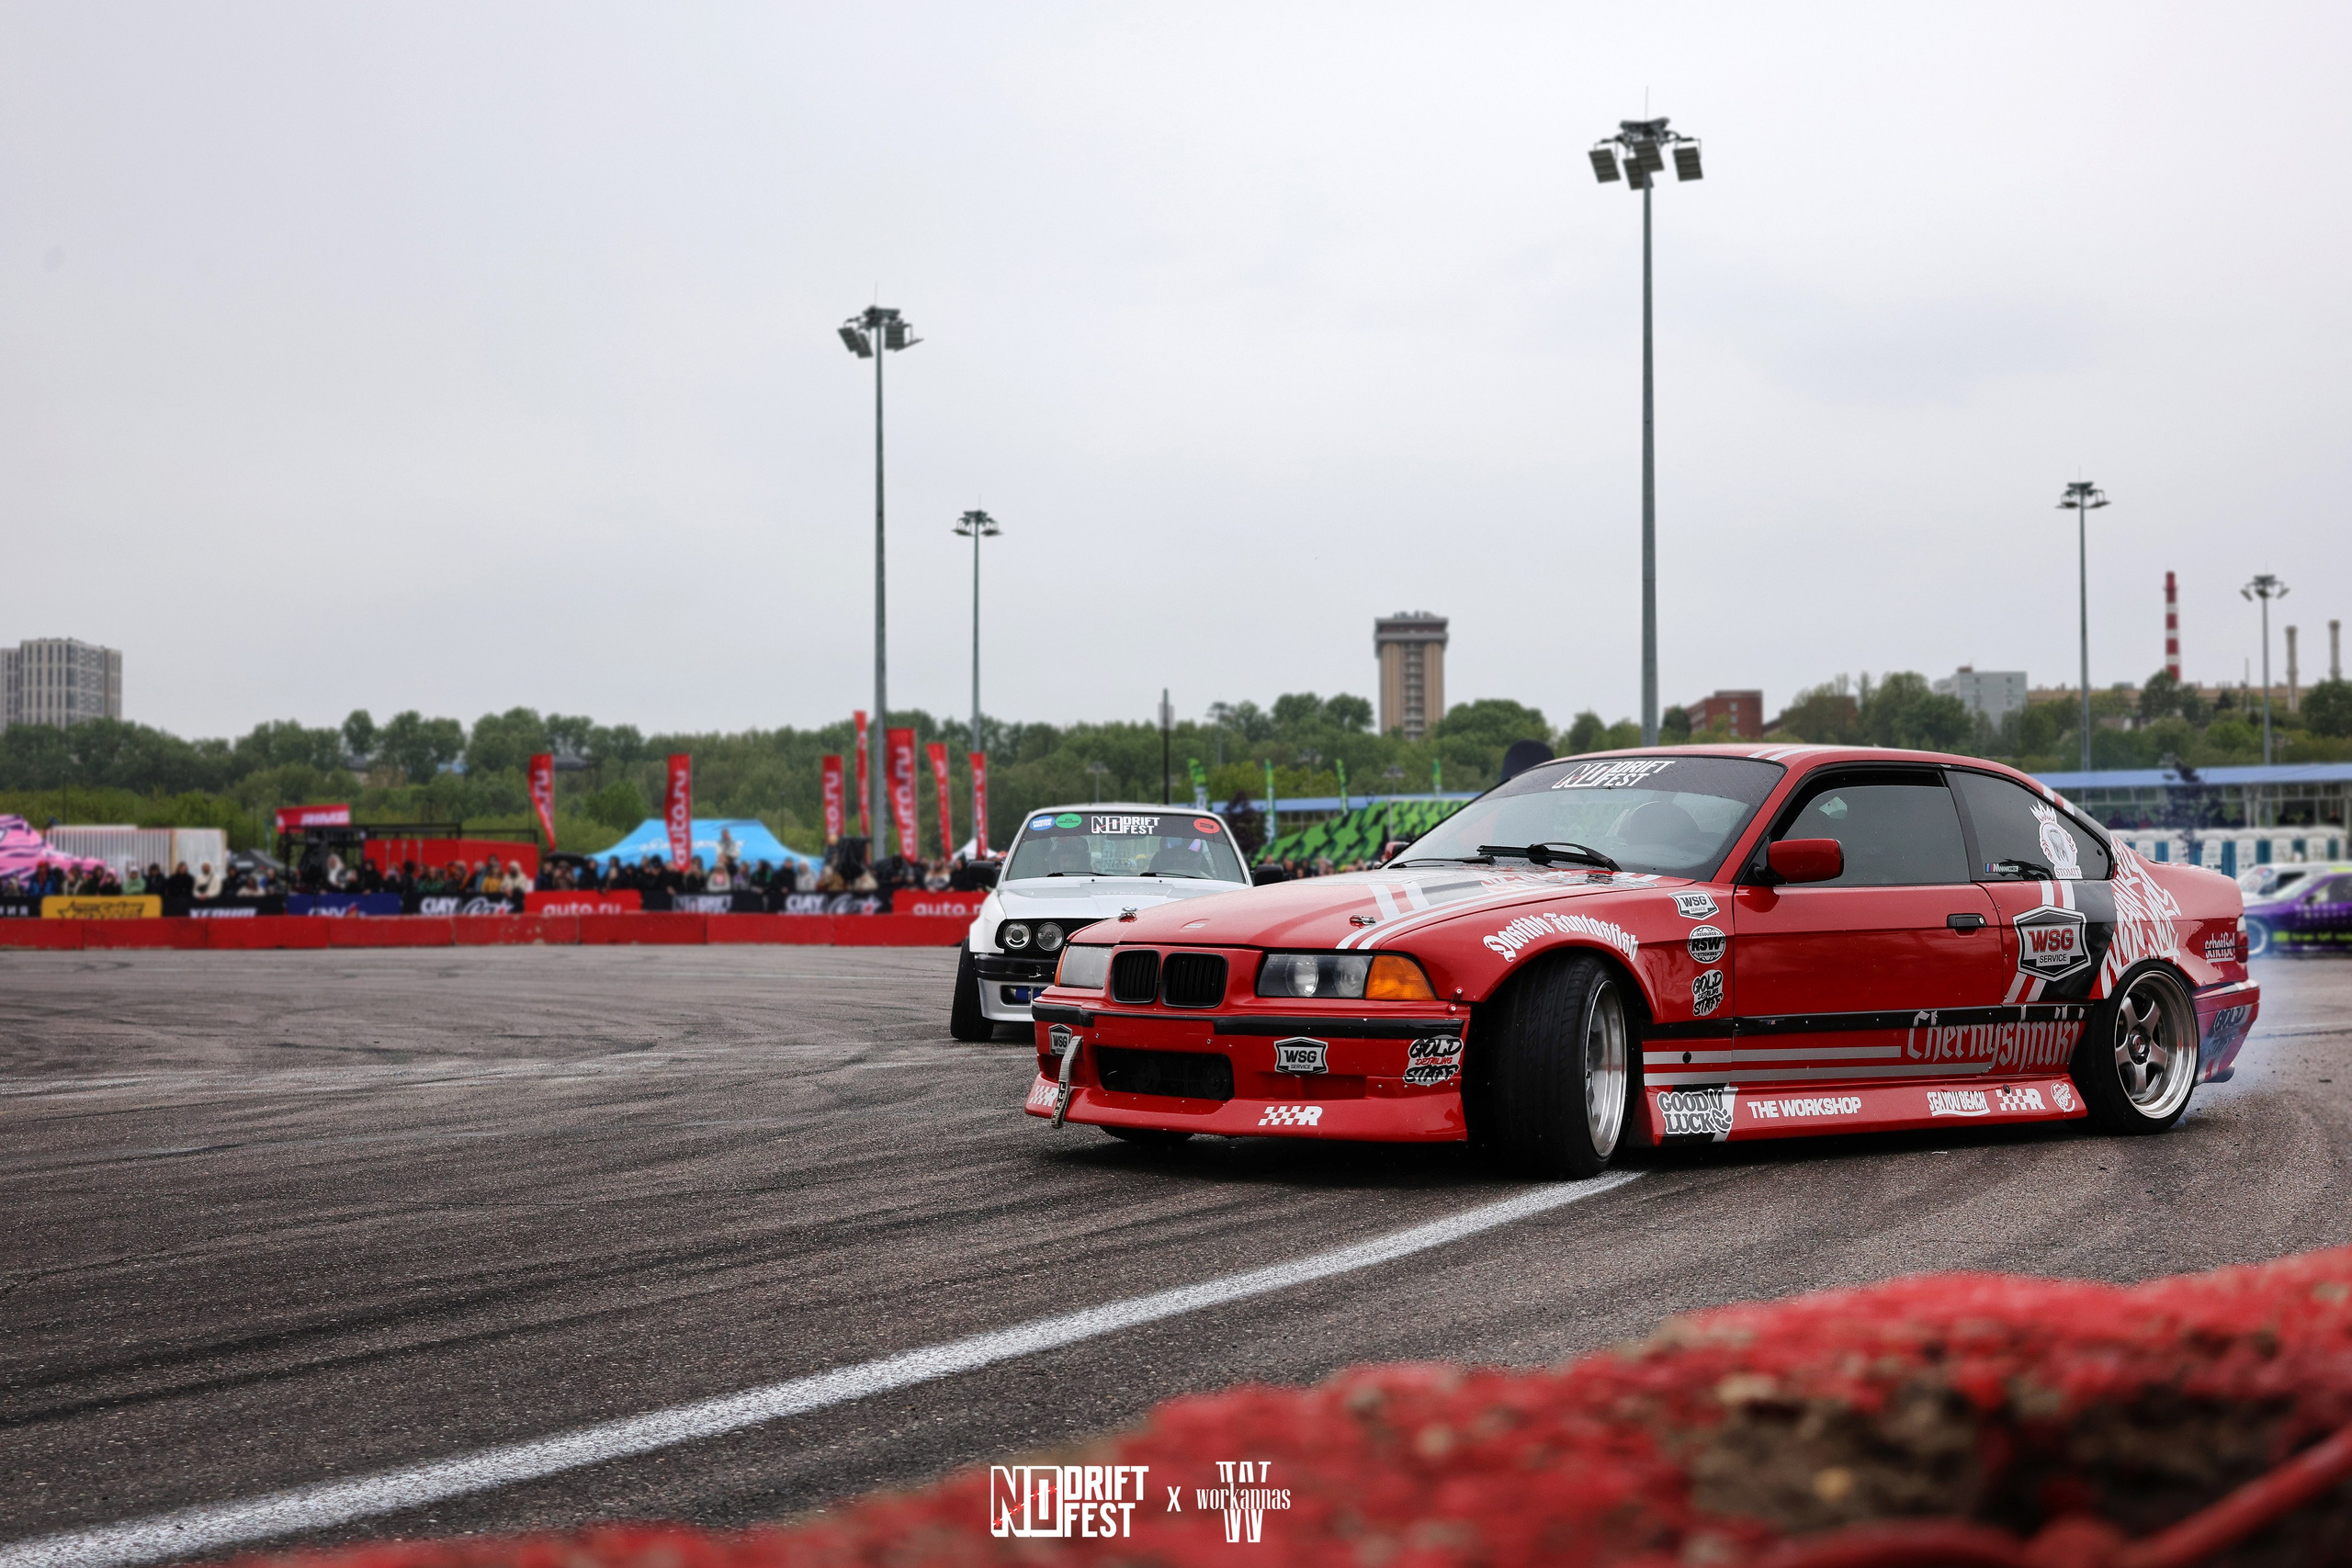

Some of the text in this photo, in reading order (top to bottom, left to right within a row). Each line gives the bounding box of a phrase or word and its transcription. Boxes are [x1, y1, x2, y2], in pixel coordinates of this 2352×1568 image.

[1609, 761, 1676, 773] DRIFT
[1593, 773, 1650, 786] FEST
[894, 747, 913, 856] auto.ru
[670, 770, 687, 865] auto.ru
[1123, 817, 1159, 826] DRIFT
[1123, 826, 1154, 834] FEST
[1680, 897, 1707, 907] WSG
[1691, 937, 1724, 951] RSW
[2028, 928, 2075, 953] WSG
[2040, 953, 2066, 963] SERVICE
[1693, 971, 1723, 994] GOLD
[1693, 993, 1723, 1015] STAFF
[1053, 1035, 1068, 1047] WSG
[1409, 1038, 1463, 1058] GOLD
[1283, 1050, 1317, 1063] WSG
[1415, 1057, 1453, 1066] DETAILING
[1404, 1065, 1459, 1082] STAFF
[1657, 1091, 1711, 1111] GOOD
[1747, 1097, 1862, 1119] THE WORKSHOP
